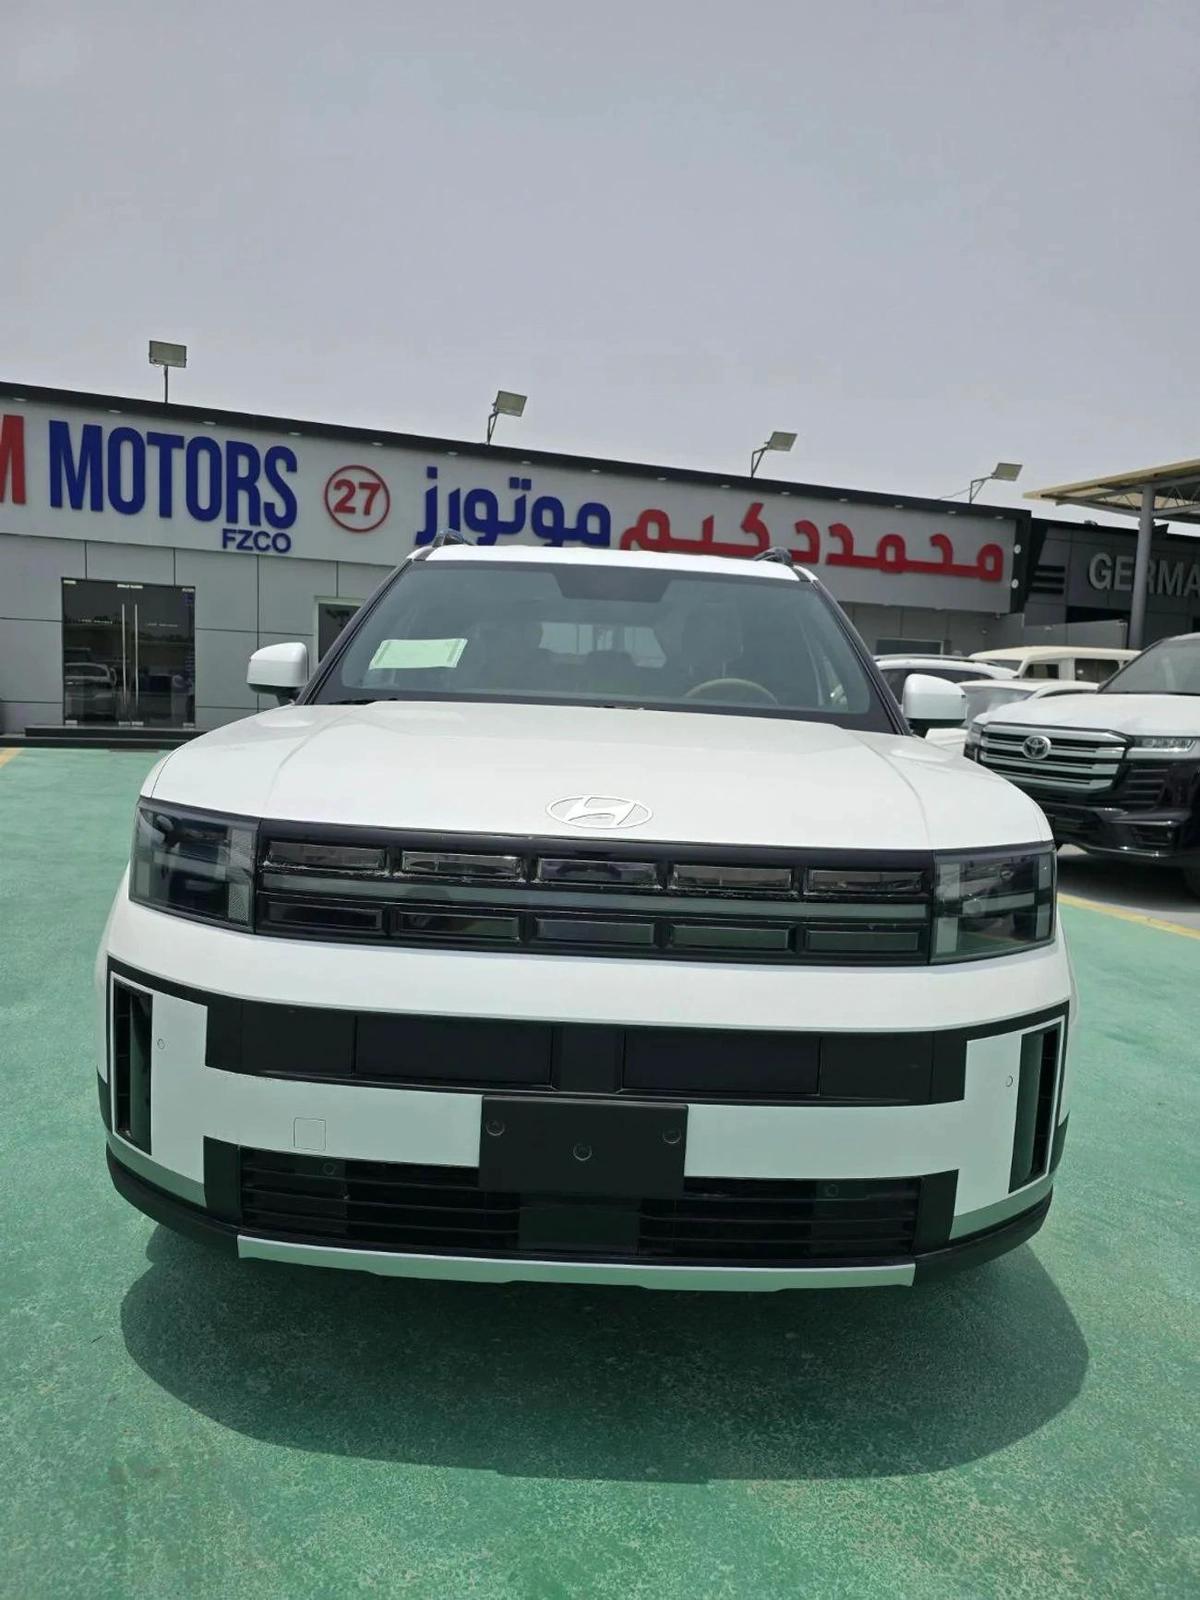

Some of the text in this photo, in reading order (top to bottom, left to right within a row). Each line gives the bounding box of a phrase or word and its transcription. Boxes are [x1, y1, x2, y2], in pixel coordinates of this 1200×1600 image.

[49, 420, 298, 530] MOTORS
[332, 478, 381, 516] 27
[414, 466, 611, 547] موتورز
[222, 528, 292, 554] FZCO
[826, 522, 1004, 582] محمد
